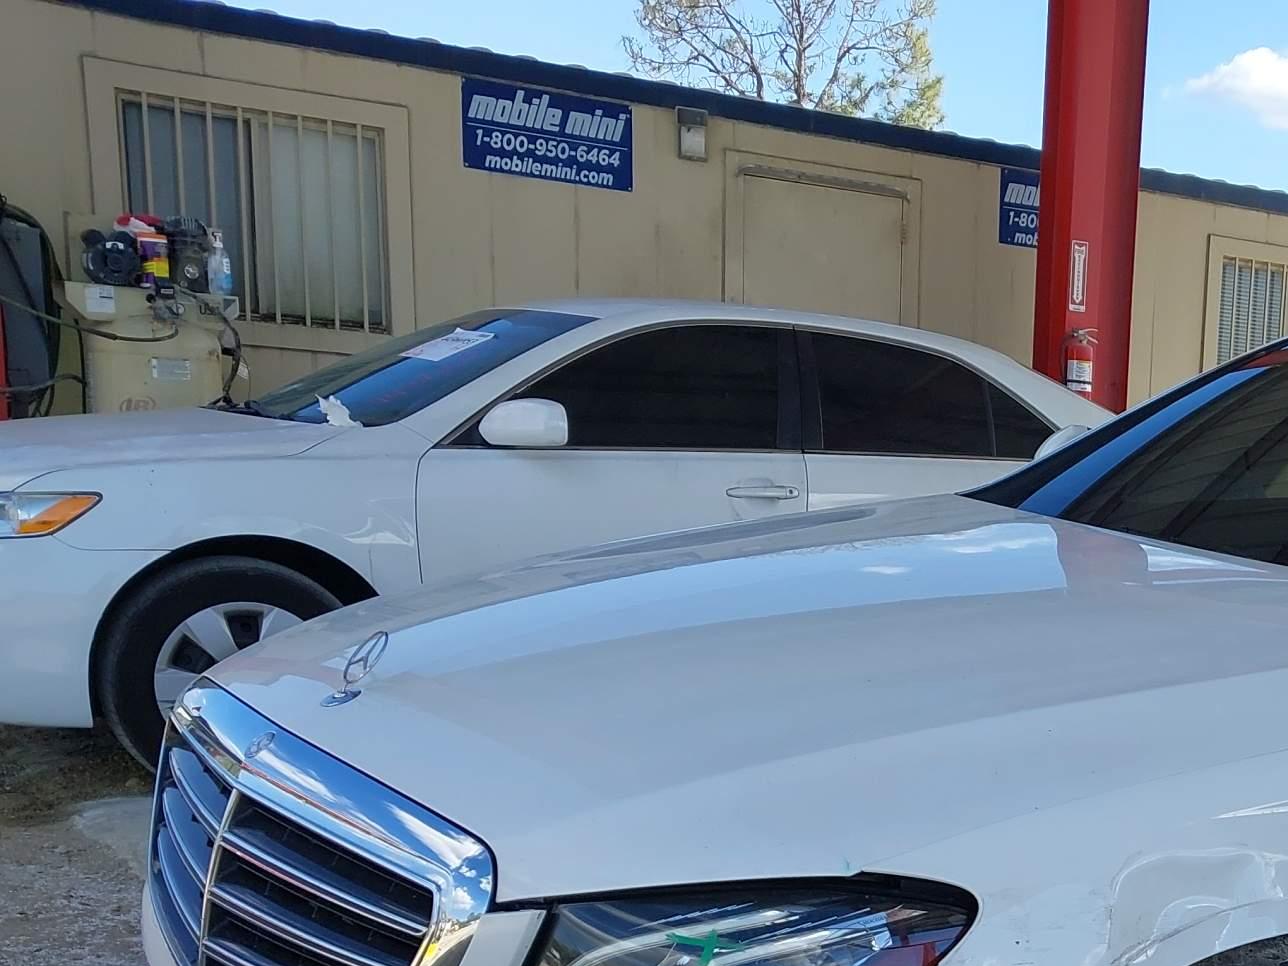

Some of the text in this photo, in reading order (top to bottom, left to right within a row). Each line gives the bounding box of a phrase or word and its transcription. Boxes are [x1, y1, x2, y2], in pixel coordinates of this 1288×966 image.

[467, 89, 627, 142] mobile mini
[475, 128, 620, 168] 1-800-950-6464
[484, 155, 614, 186] mobilemini.com
[1008, 211, 1040, 229] 1-80
